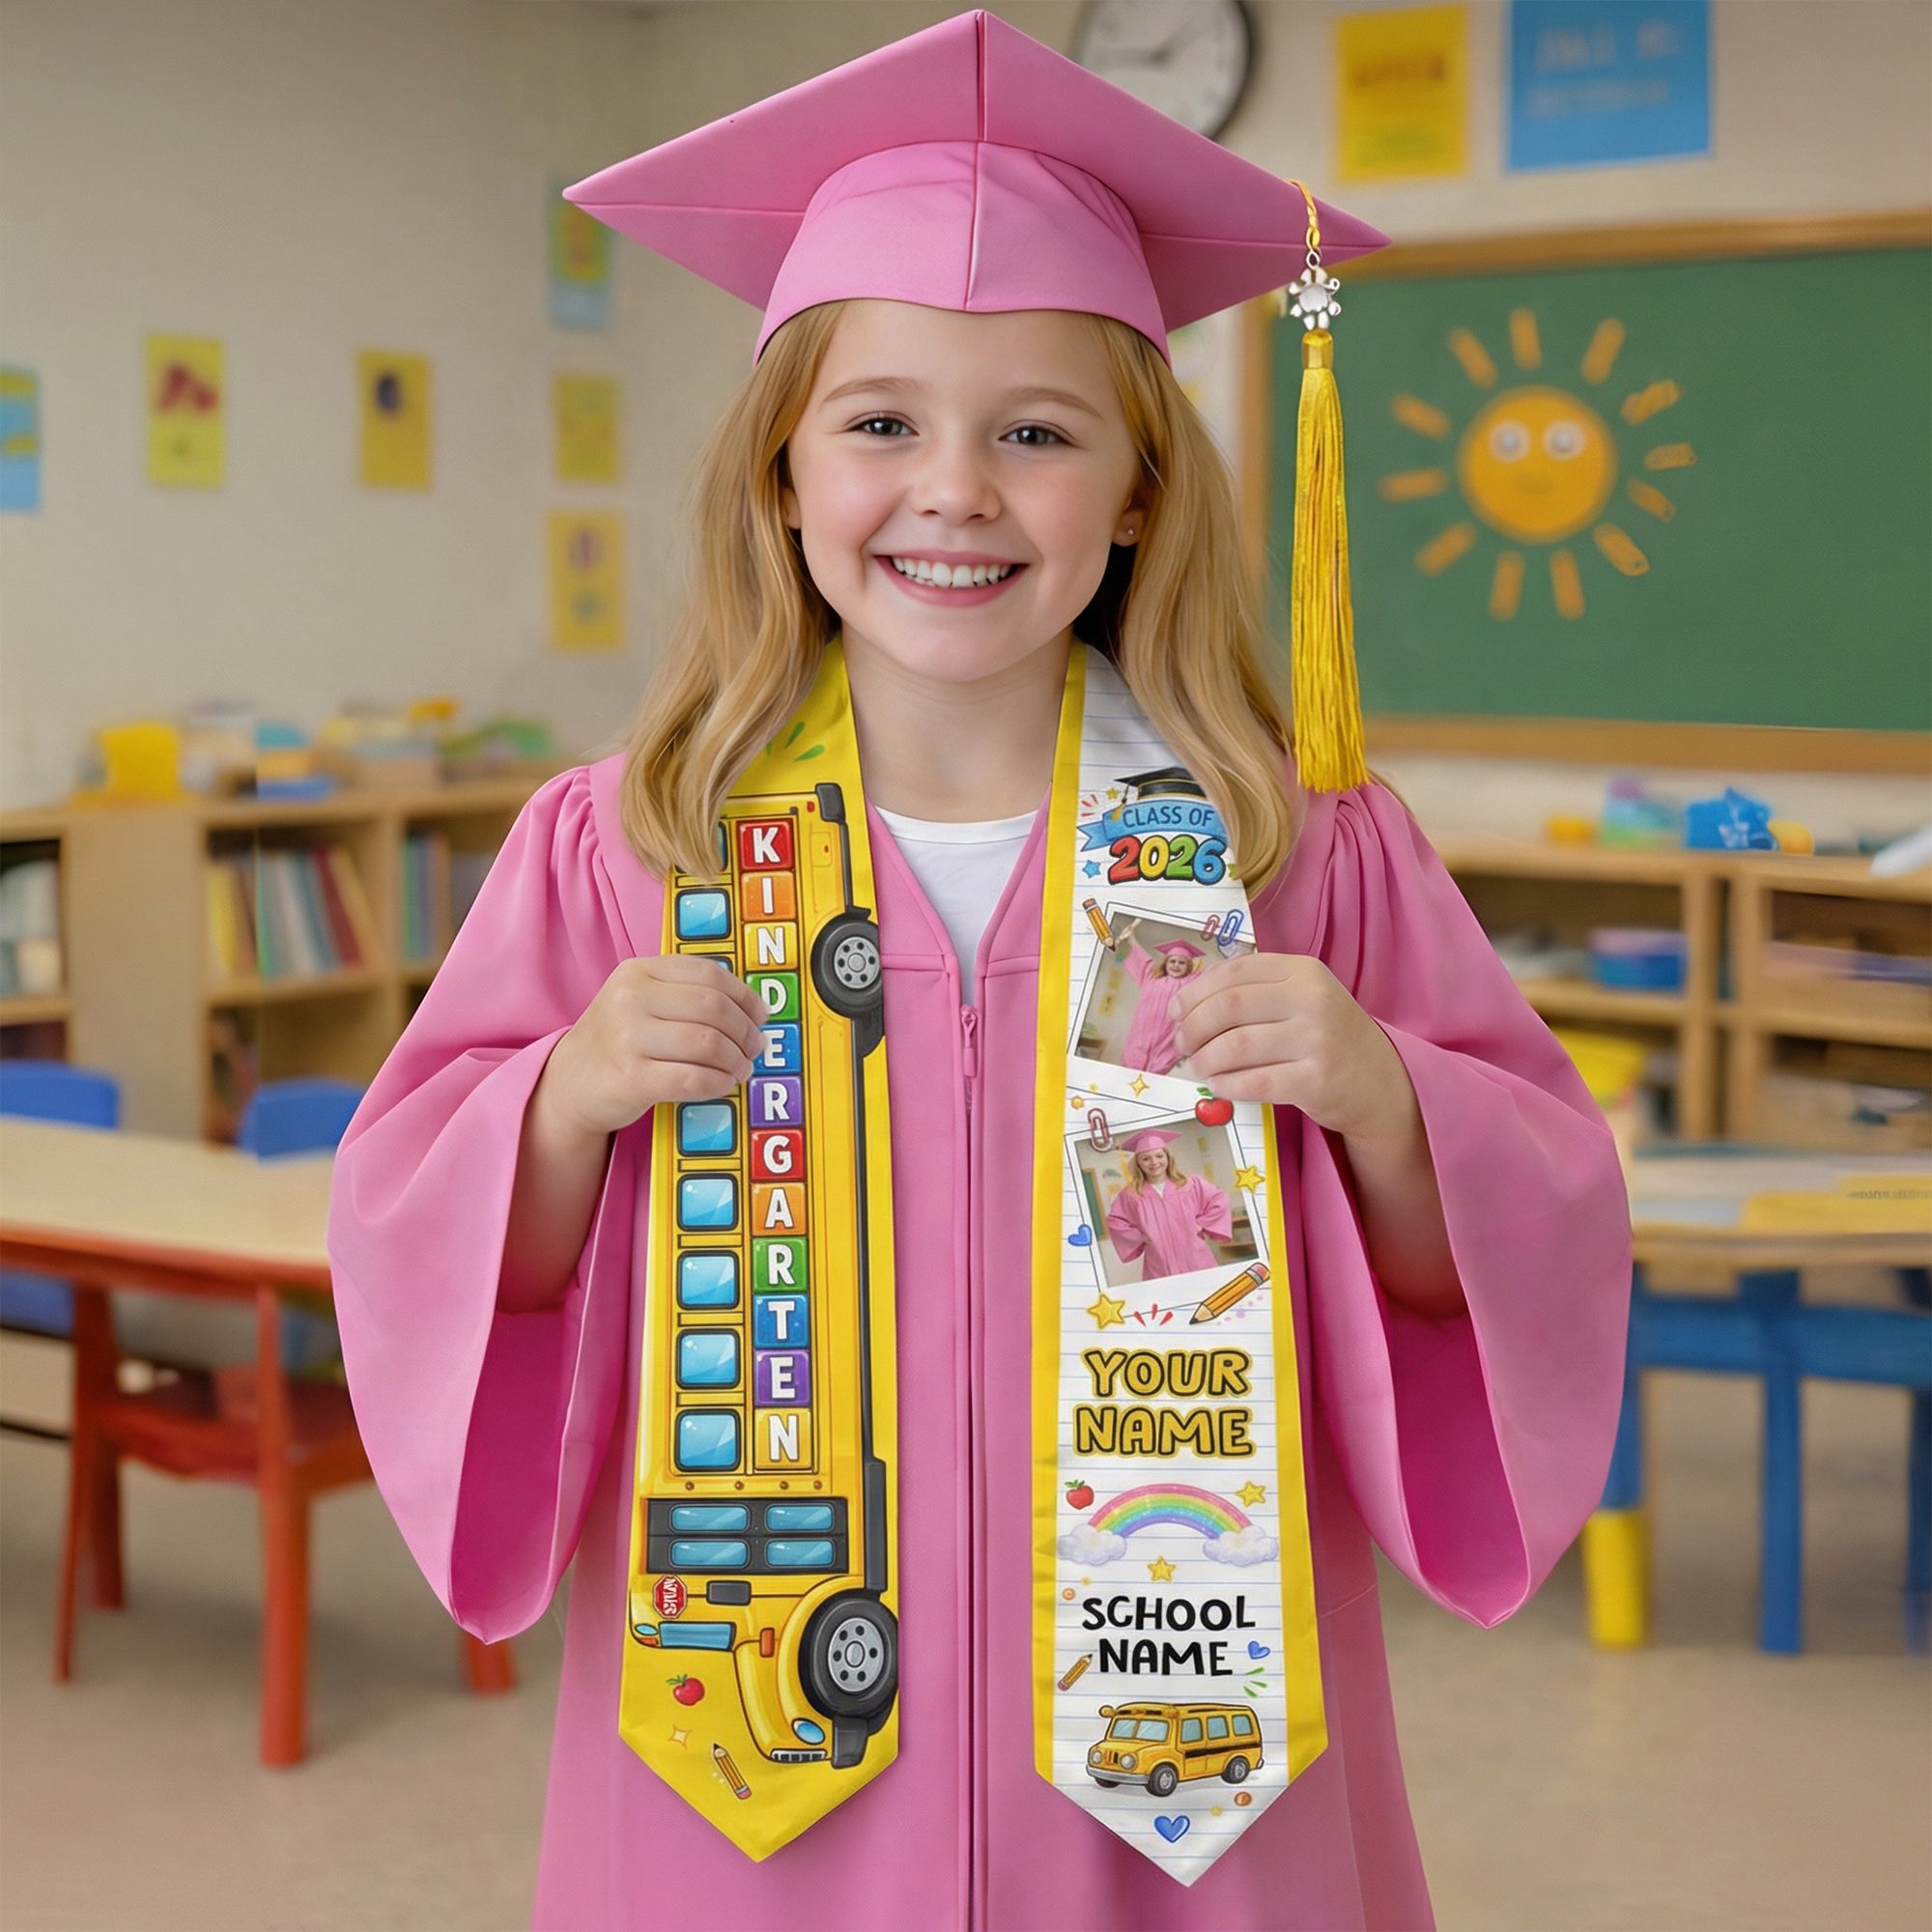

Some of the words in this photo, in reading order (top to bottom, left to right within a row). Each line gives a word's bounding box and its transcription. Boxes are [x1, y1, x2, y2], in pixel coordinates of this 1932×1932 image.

[1122, 806, 1182, 828] CLASS
[1189, 805, 1215, 827] OF
[1107, 834, 1228, 886] 2026
[752, 826, 800, 1462] KINDERGARTEN
[1083, 1349, 1251, 1398] YOUR
[1074, 1406, 1254, 1456] NAME
[1081, 1595, 1256, 1632] SCHOOL
[1098, 1638, 1233, 1676] NAME
